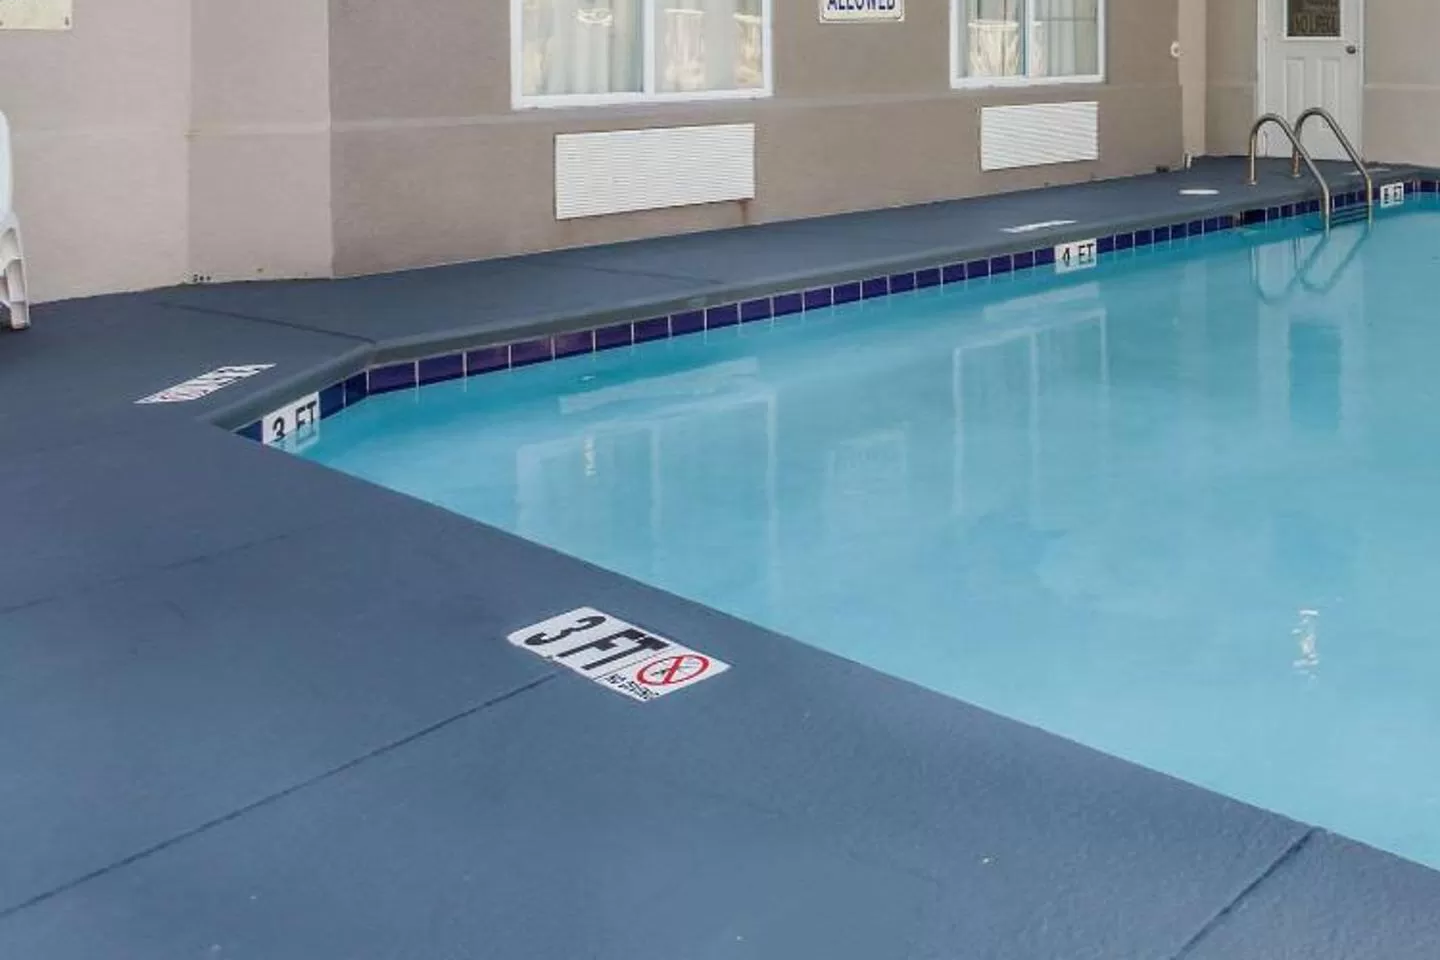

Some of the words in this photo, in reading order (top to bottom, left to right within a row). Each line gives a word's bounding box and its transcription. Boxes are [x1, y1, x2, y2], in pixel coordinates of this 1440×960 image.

[295, 400, 317, 429] FT
[523, 615, 607, 646] 3
[556, 627, 671, 671] FT
